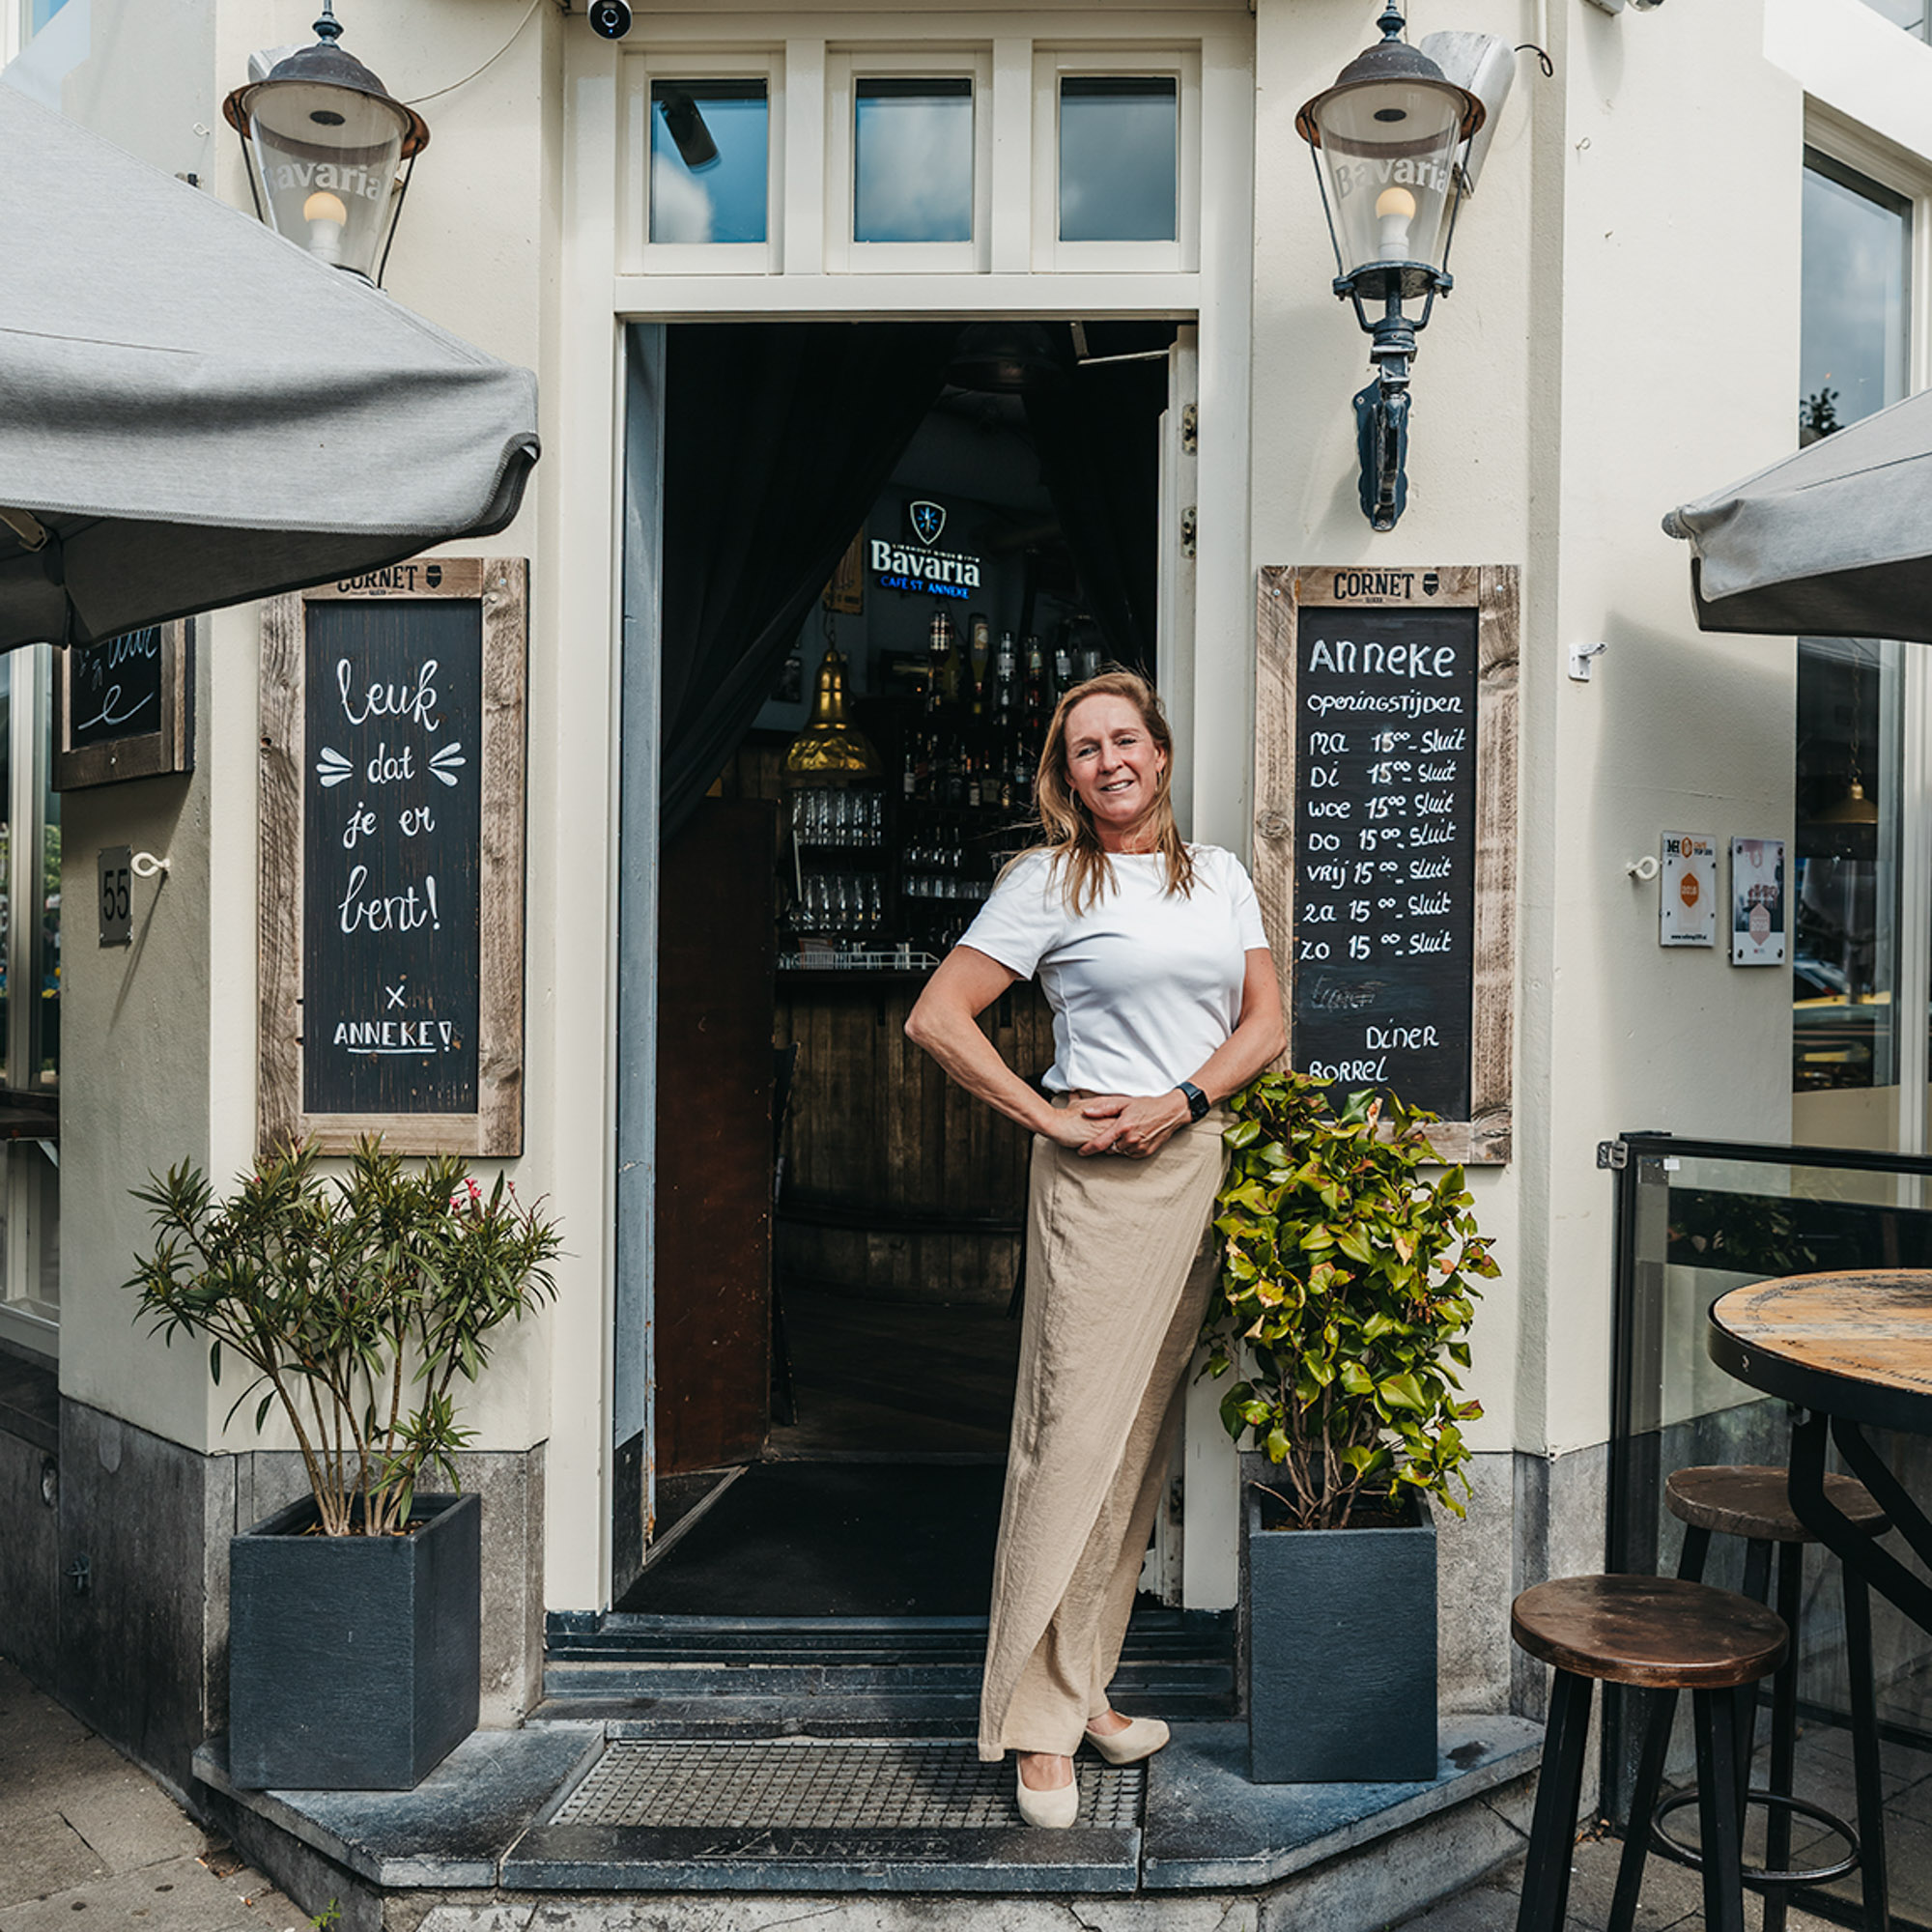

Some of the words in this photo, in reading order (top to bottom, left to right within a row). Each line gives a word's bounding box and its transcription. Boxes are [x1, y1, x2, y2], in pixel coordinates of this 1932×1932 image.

[1336, 157, 1447, 199] Bavaria
[870, 539, 980, 587] Bavaria
[1334, 572, 1414, 599] CORNET
[337, 658, 440, 732] leuk
[367, 742, 415, 784] dat
[343, 801, 377, 849] je
[398, 806, 435, 837] er
[103, 868, 128, 921] 55
[338, 865, 440, 933] bent!
